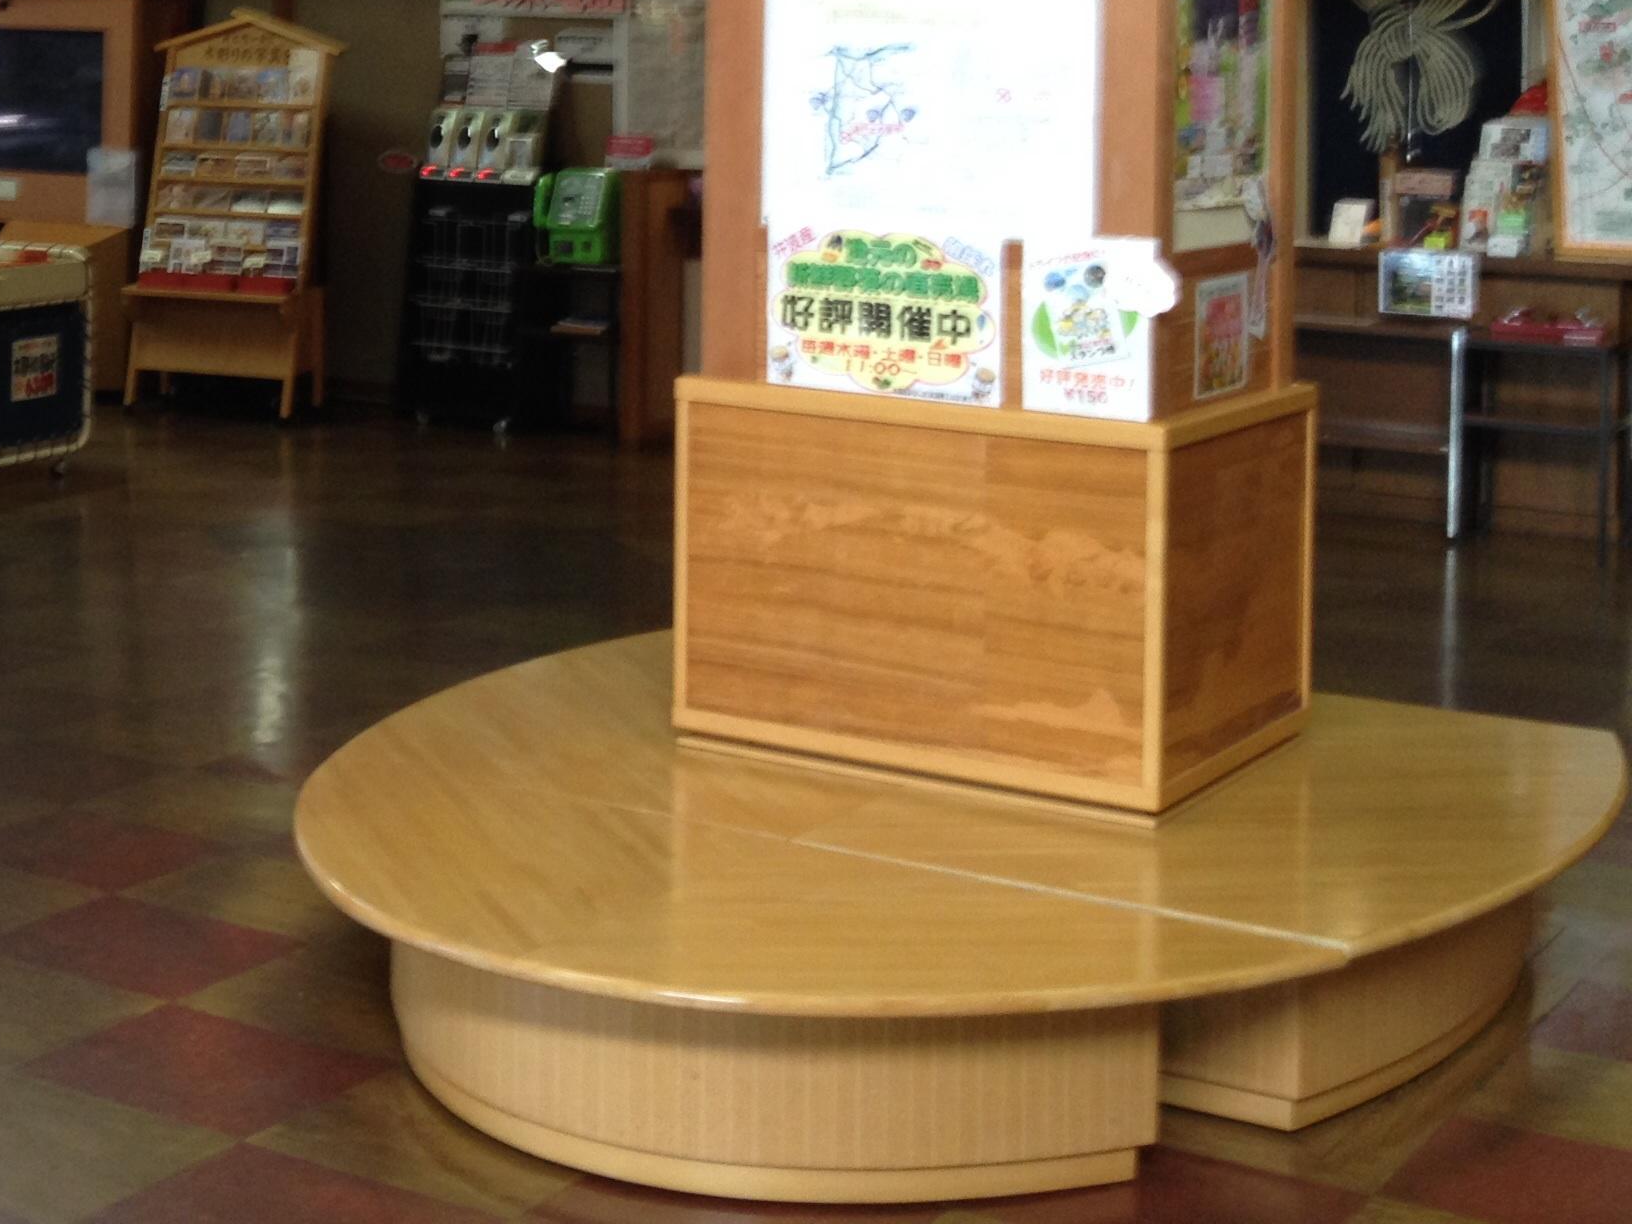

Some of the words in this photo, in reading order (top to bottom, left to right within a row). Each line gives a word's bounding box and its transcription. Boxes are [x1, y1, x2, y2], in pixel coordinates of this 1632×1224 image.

[780, 294, 973, 346] 好評開催中
